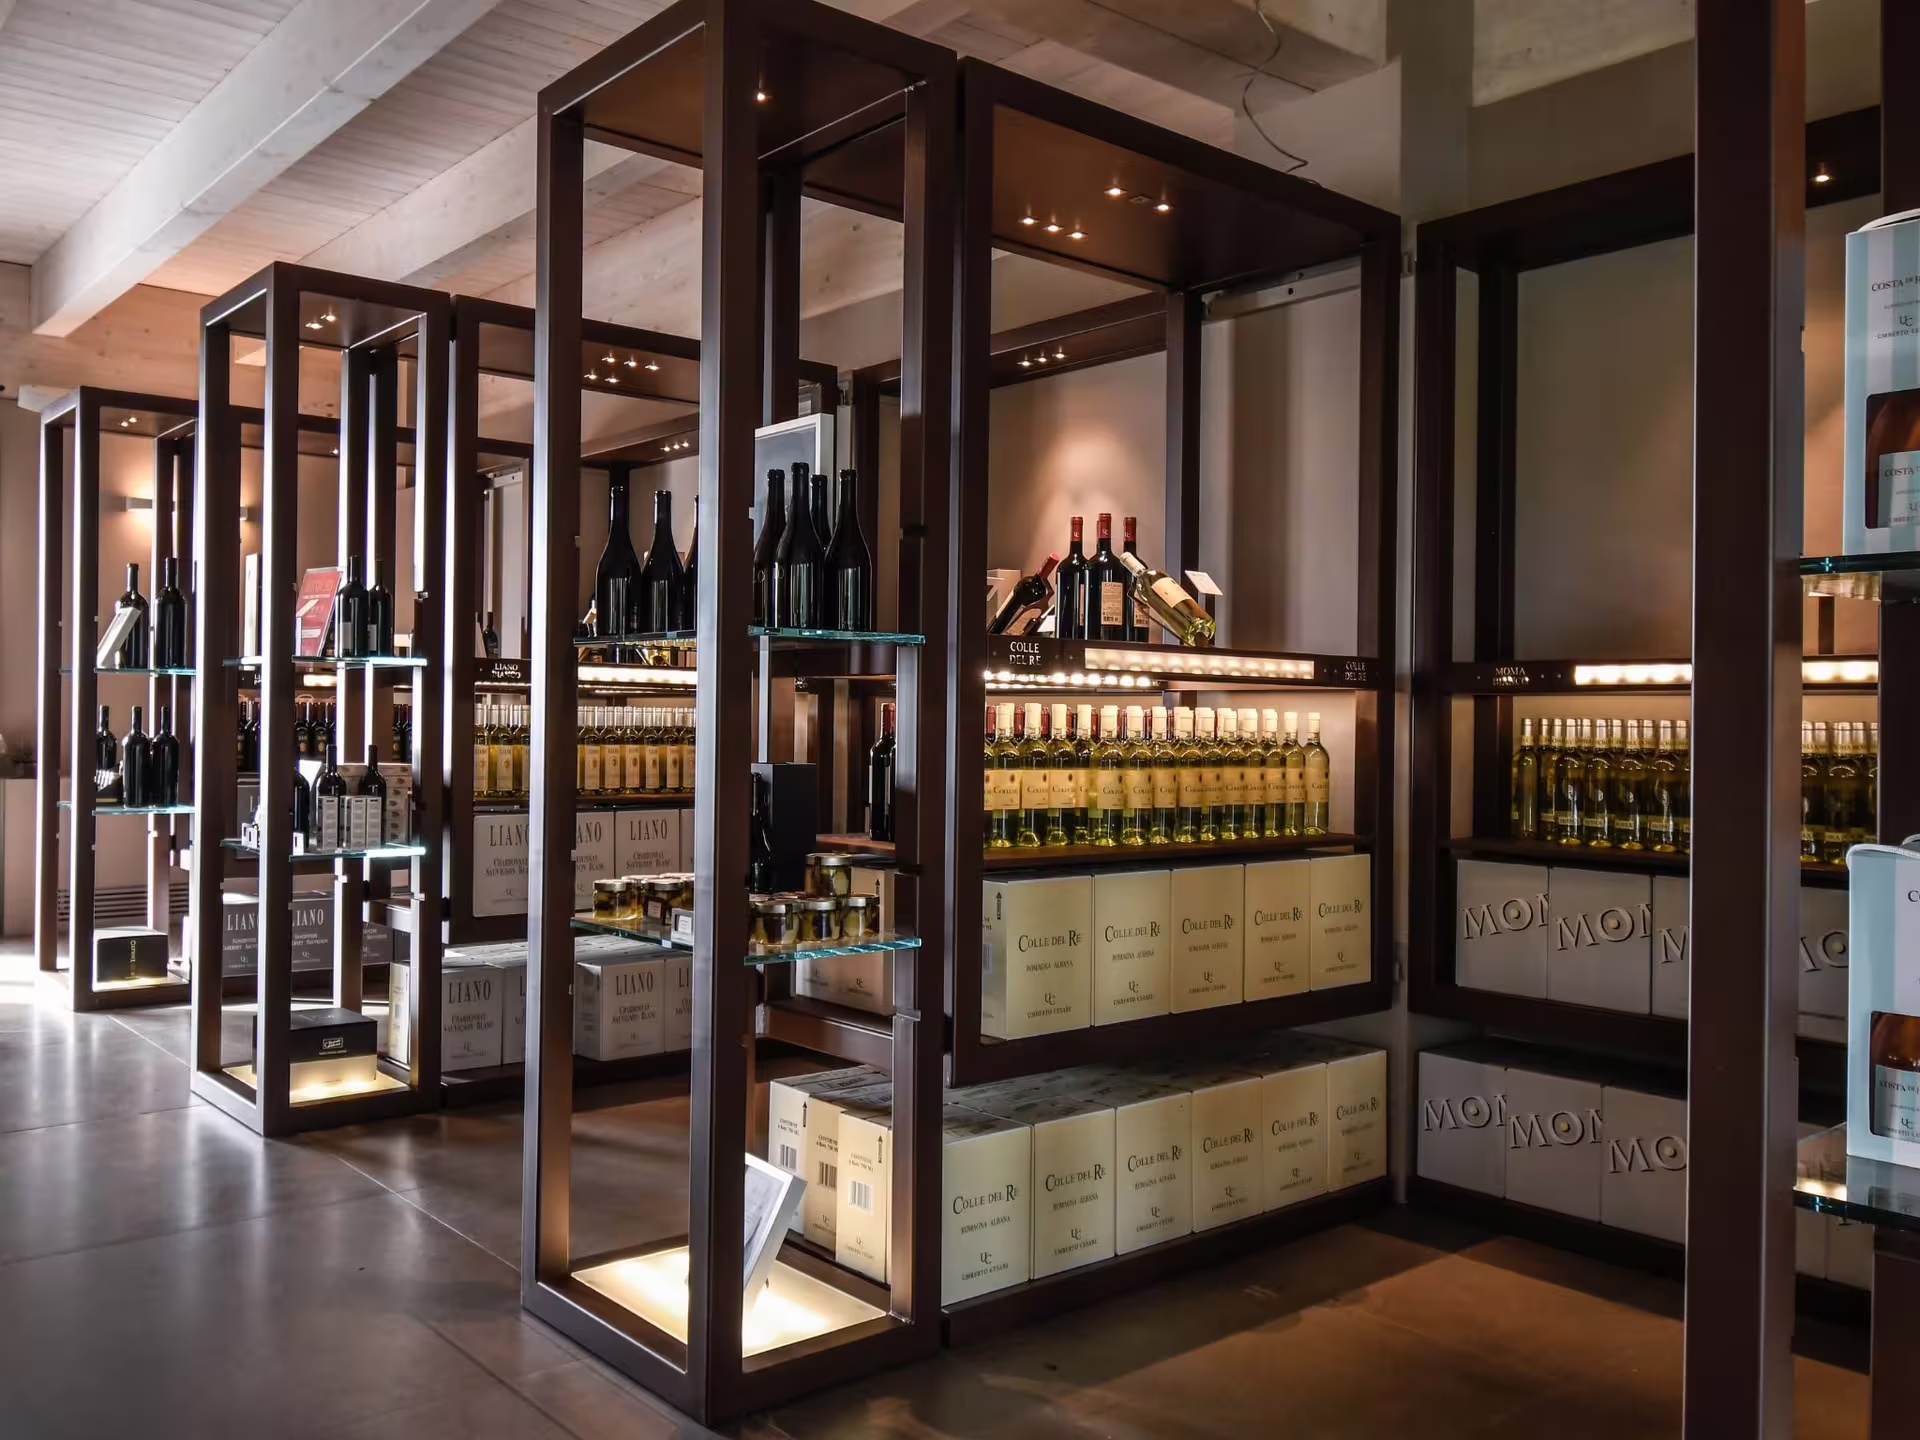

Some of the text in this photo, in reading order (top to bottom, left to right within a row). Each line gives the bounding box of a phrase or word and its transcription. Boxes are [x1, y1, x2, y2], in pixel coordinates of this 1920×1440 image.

[1010, 641, 1040, 653] COLLE
[494, 663, 519, 671] LIANO
[1009, 654, 1042, 666] DEL RE
[1495, 666, 1526, 676] MOMA
[577, 821, 602, 843] ANO
[630, 818, 668, 841] LIANO
[1105, 925, 1133, 942] COLLE
[1182, 918, 1208, 934] COLLE
[1019, 934, 1050, 952] COLLE
[616, 971, 654, 995] LIANO
[449, 980, 491, 1004] LIANO
[1128, 1155, 1154, 1172] COLLE
[1045, 1174, 1075, 1192] COLLE
[953, 1196, 986, 1215] COLLE
